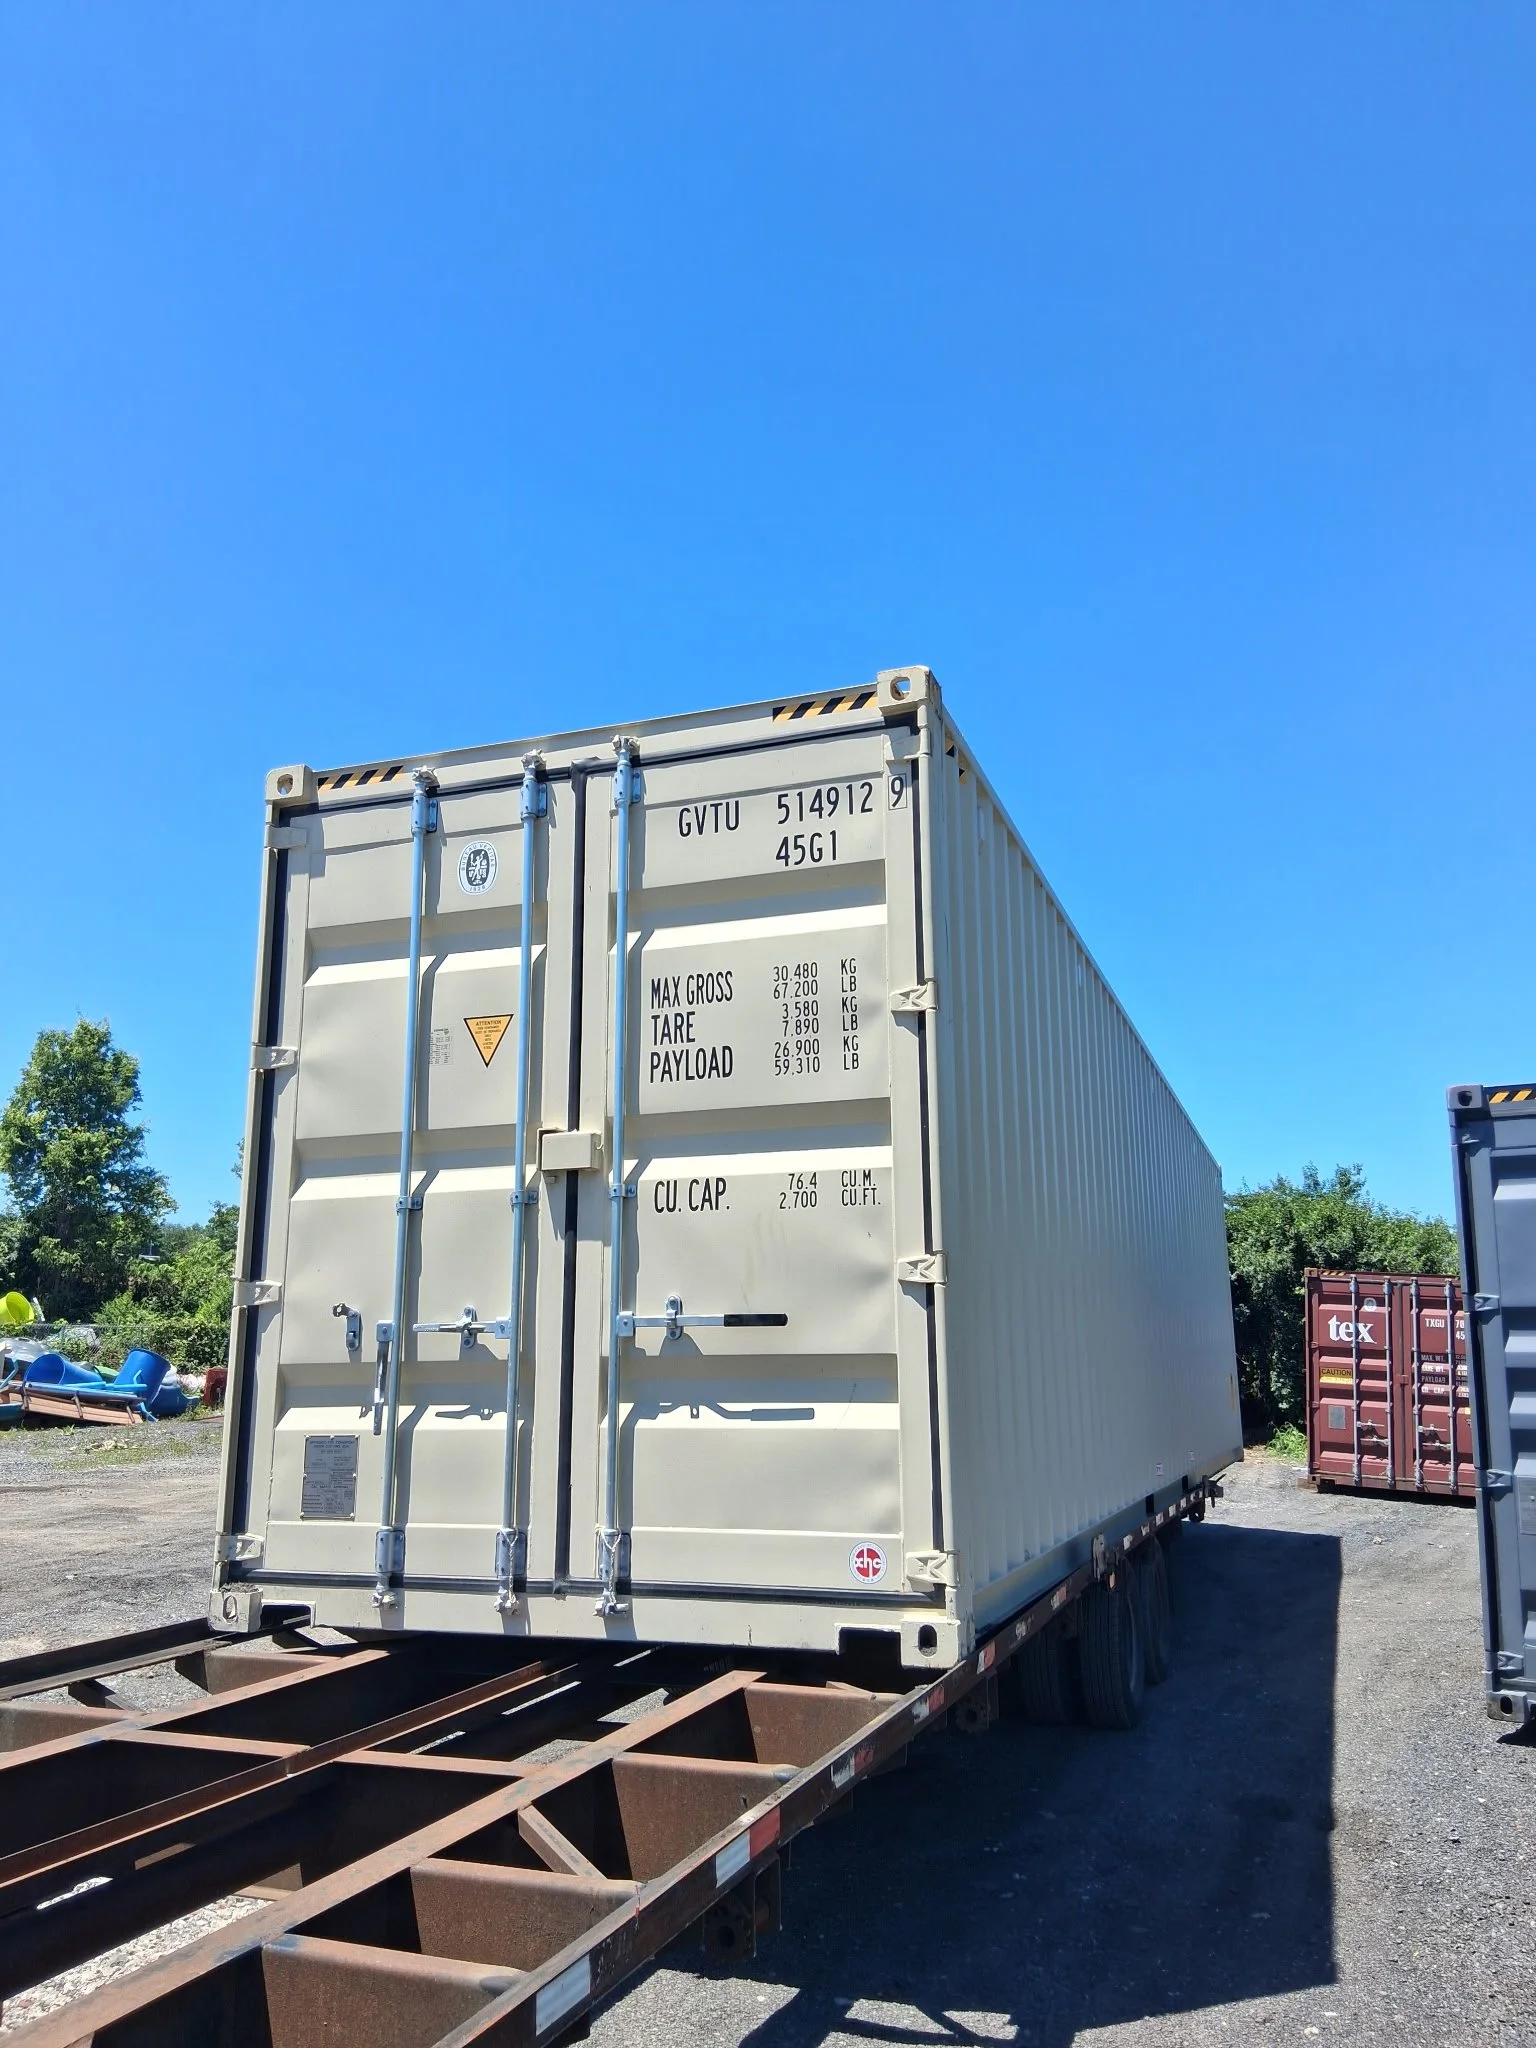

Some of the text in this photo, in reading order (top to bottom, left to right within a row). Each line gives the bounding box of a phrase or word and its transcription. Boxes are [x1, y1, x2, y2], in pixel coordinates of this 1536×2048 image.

[678, 776, 905, 838] GVTU 514912 9
[775, 829, 837, 868] 45G1
[650, 957, 857, 1010] MAX GROSS 30.480 KG
[773, 975, 857, 1000] 67.200 LB
[650, 995, 858, 1047] TARE 3.580 KG
[781, 1013, 859, 1038] 7.890 LB
[649, 1034, 859, 1084] PAYLOAD 26.900 KG
[774, 1052, 860, 1077] 59.310 LB
[653, 1179, 682, 1214] CU.
[688, 1177, 730, 1212] CAP.
[787, 1171, 818, 1191] 76.4
[779, 1190, 818, 1210] 2.700
[1425, 1318, 1445, 1328] TXGU
[1321, 1368, 1352, 1376] CAUTION
